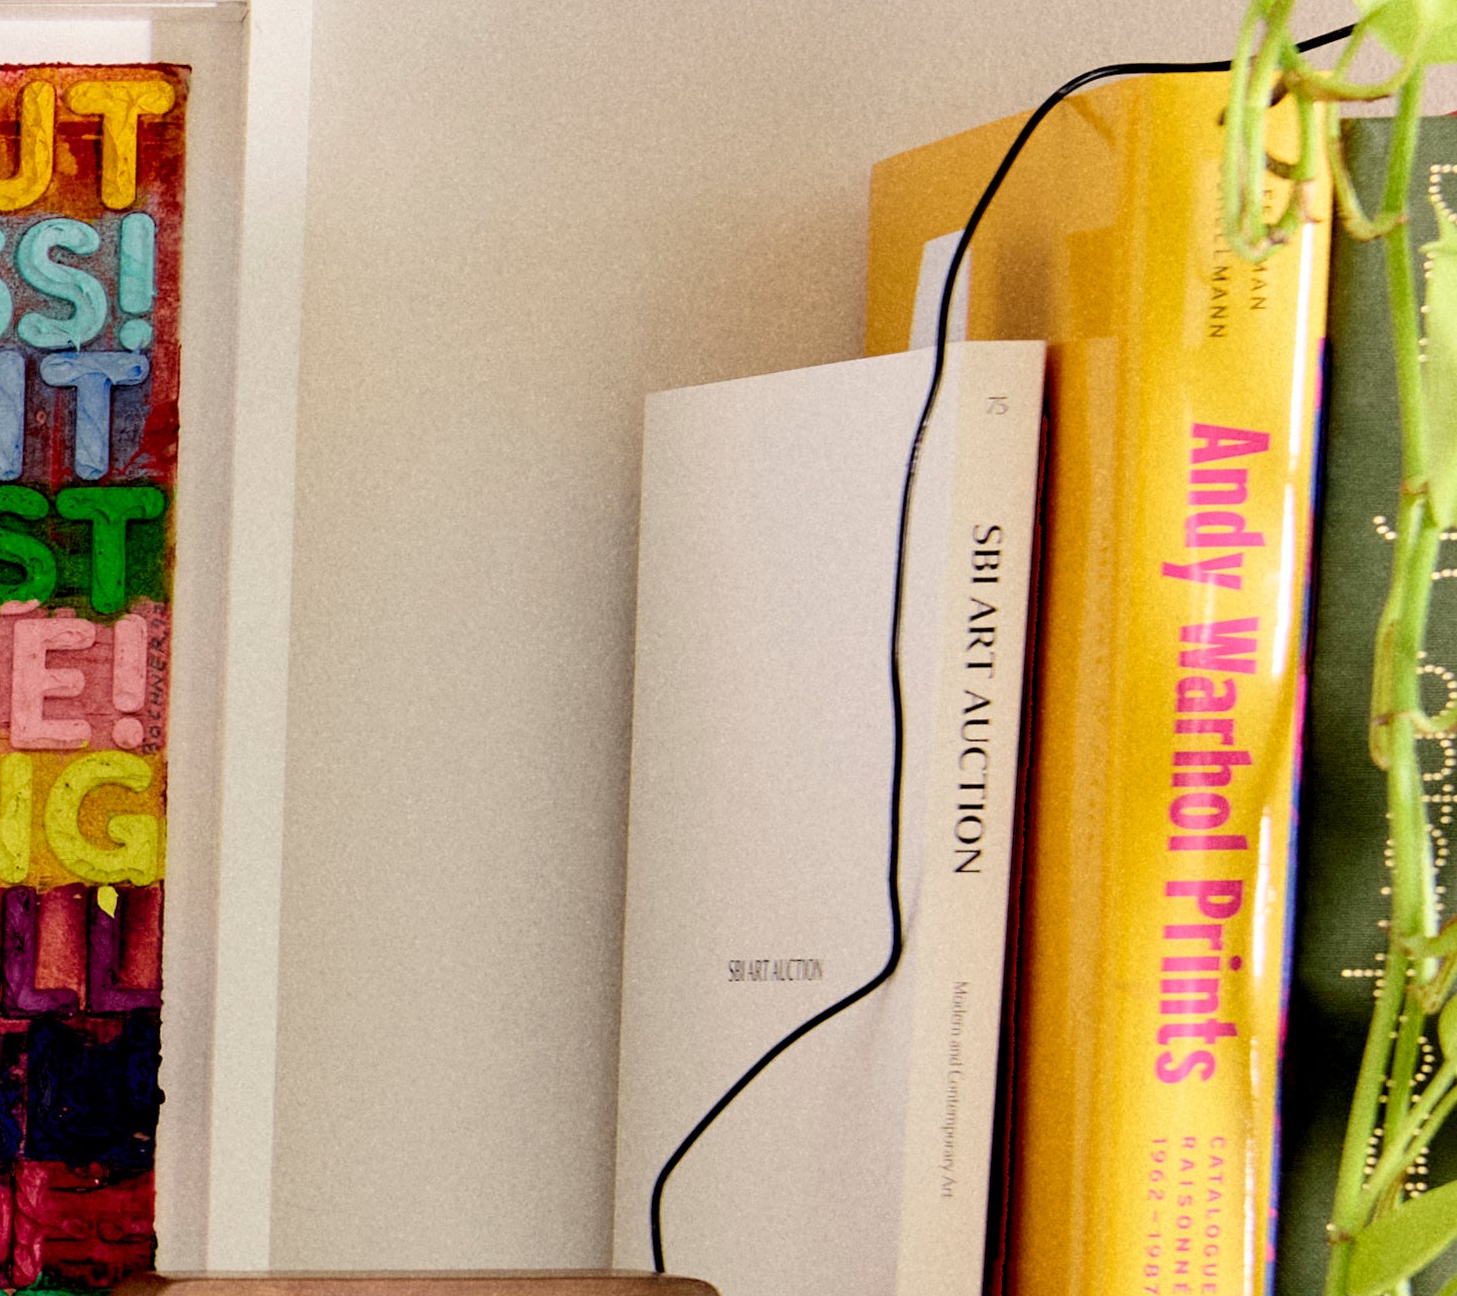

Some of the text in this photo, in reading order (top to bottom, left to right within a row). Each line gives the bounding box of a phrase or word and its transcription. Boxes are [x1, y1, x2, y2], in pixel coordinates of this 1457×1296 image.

[952, 524, 1003, 874] SBI ART AUCTION
[1154, 422, 1271, 1085] Andy Warhol Prints
[939, 981, 970, 1199] Modern and Contemporary Art
[1173, 1136, 1198, 1295] RAISONNÉ
[1201, 1136, 1228, 1295] CATALOGUE
